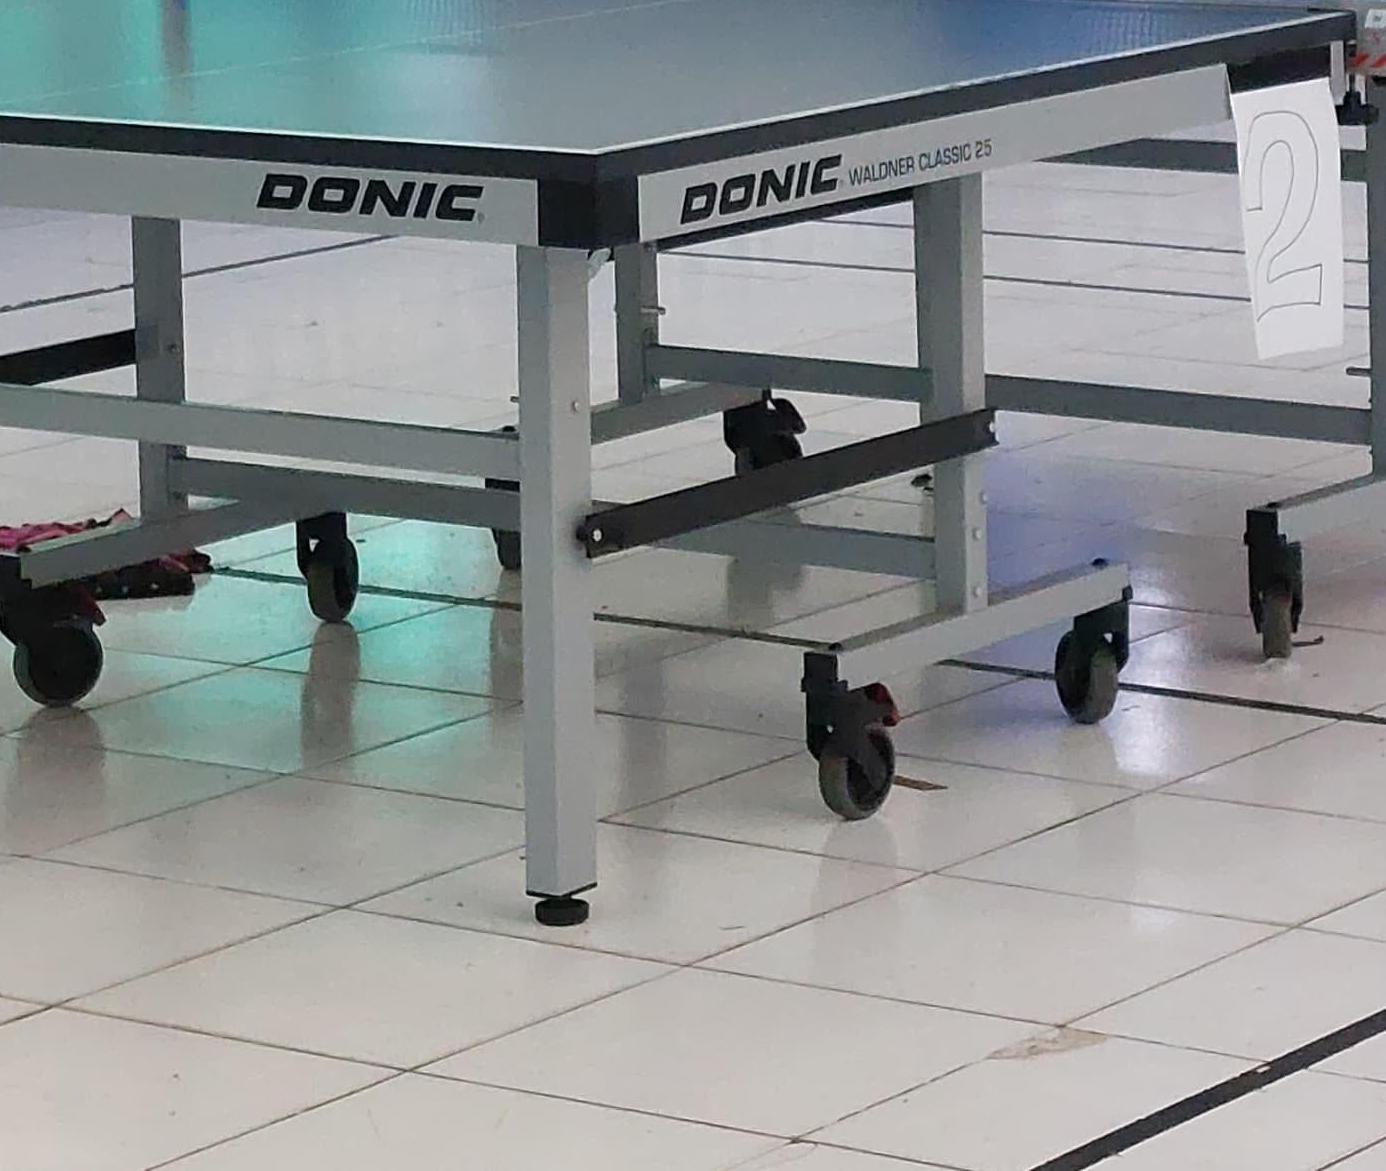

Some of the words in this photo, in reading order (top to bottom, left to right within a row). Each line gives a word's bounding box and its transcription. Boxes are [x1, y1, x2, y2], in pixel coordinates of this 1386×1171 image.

[256, 173, 484, 222] DONIC
[679, 154, 842, 225] DONIC
[848, 155, 914, 187] WALDNER
[917, 142, 973, 172] CLASSIC
[974, 138, 993, 158] 25
[1242, 110, 1323, 323] 2
